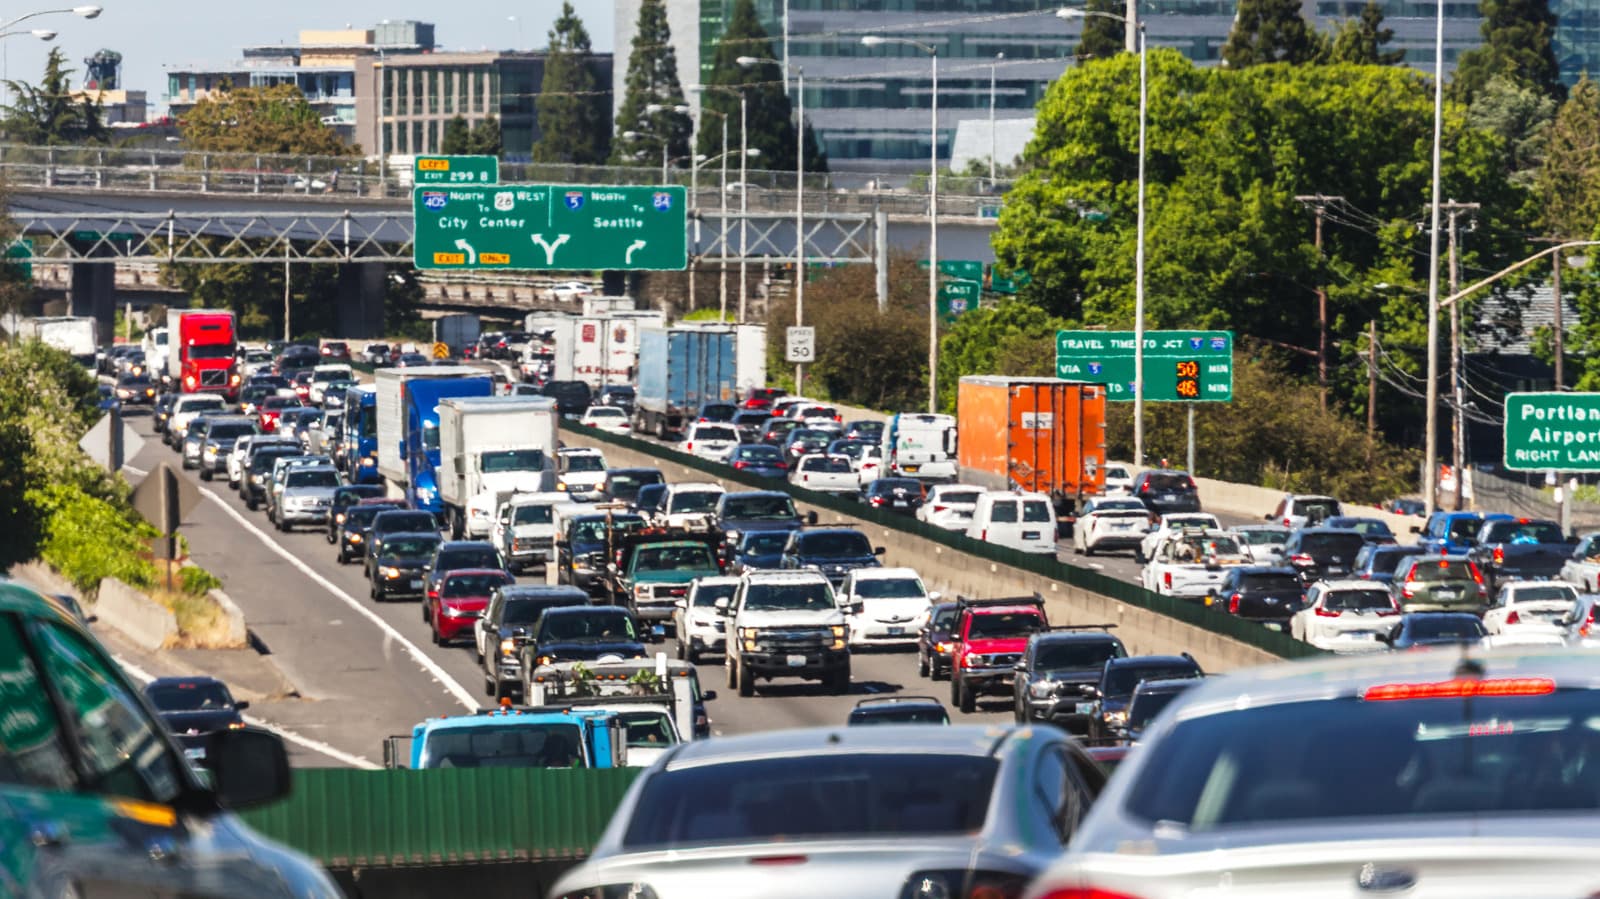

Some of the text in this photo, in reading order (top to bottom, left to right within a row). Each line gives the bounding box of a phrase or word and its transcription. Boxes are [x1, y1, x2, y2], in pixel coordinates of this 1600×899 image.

[421, 160, 446, 169] LEFT
[424, 172, 443, 180] EXIT
[450, 171, 474, 181] 299
[425, 191, 484, 207] 405 NORTH
[516, 191, 545, 201] WEST
[570, 191, 626, 208] 5 NORTH
[653, 197, 670, 208] 84
[438, 216, 525, 229] City Center
[593, 217, 643, 228] Seattle
[946, 284, 972, 294] EAST
[1062, 340, 1104, 349] TRAVEL
[1163, 340, 1183, 348] JCT
[792, 346, 810, 357] 50
[1060, 365, 1080, 374] VIA
[1177, 362, 1198, 377] 50
[1208, 364, 1228, 373] MIN
[1176, 381, 1197, 395] 46
[1208, 383, 1228, 392] MIN
[1521, 404, 1600, 421] Portlan
[1528, 426, 1600, 446] Airpor
[1515, 448, 1600, 462] RIGHT LAN
